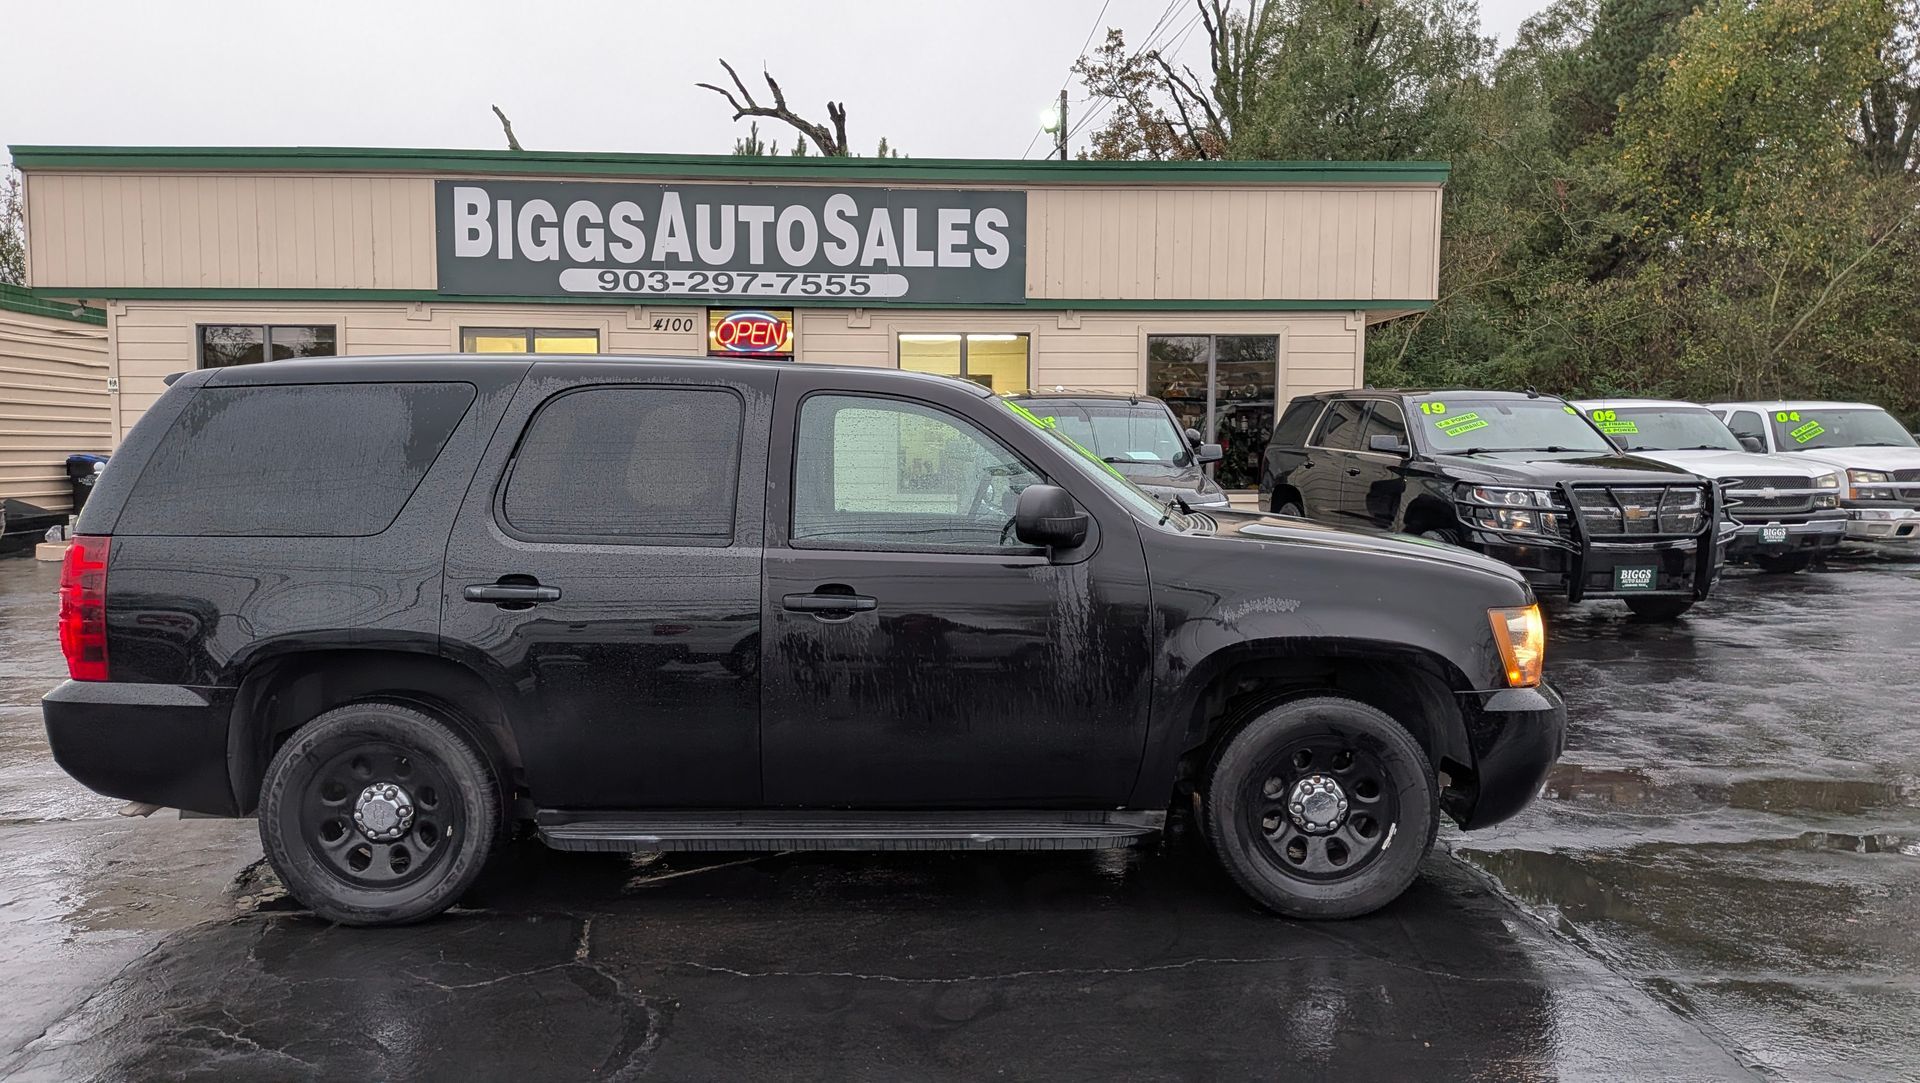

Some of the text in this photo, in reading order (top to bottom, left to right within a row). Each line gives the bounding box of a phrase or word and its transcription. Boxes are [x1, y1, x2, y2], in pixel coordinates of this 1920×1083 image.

[453, 186, 1010, 270] BIGGS AUTO SALES
[597, 270, 872, 297] 903-297-7555
[653, 318, 693, 332] 4100
[717, 321, 786, 345] OPEN
[1420, 402, 1446, 415] 19
[1451, 413, 1476, 424] POWER
[1592, 410, 1617, 422] 05
[1459, 421, 1486, 432] FINANCE
[1763, 528, 1786, 536] BIGGS
[1620, 569, 1652, 579] BIGGS
